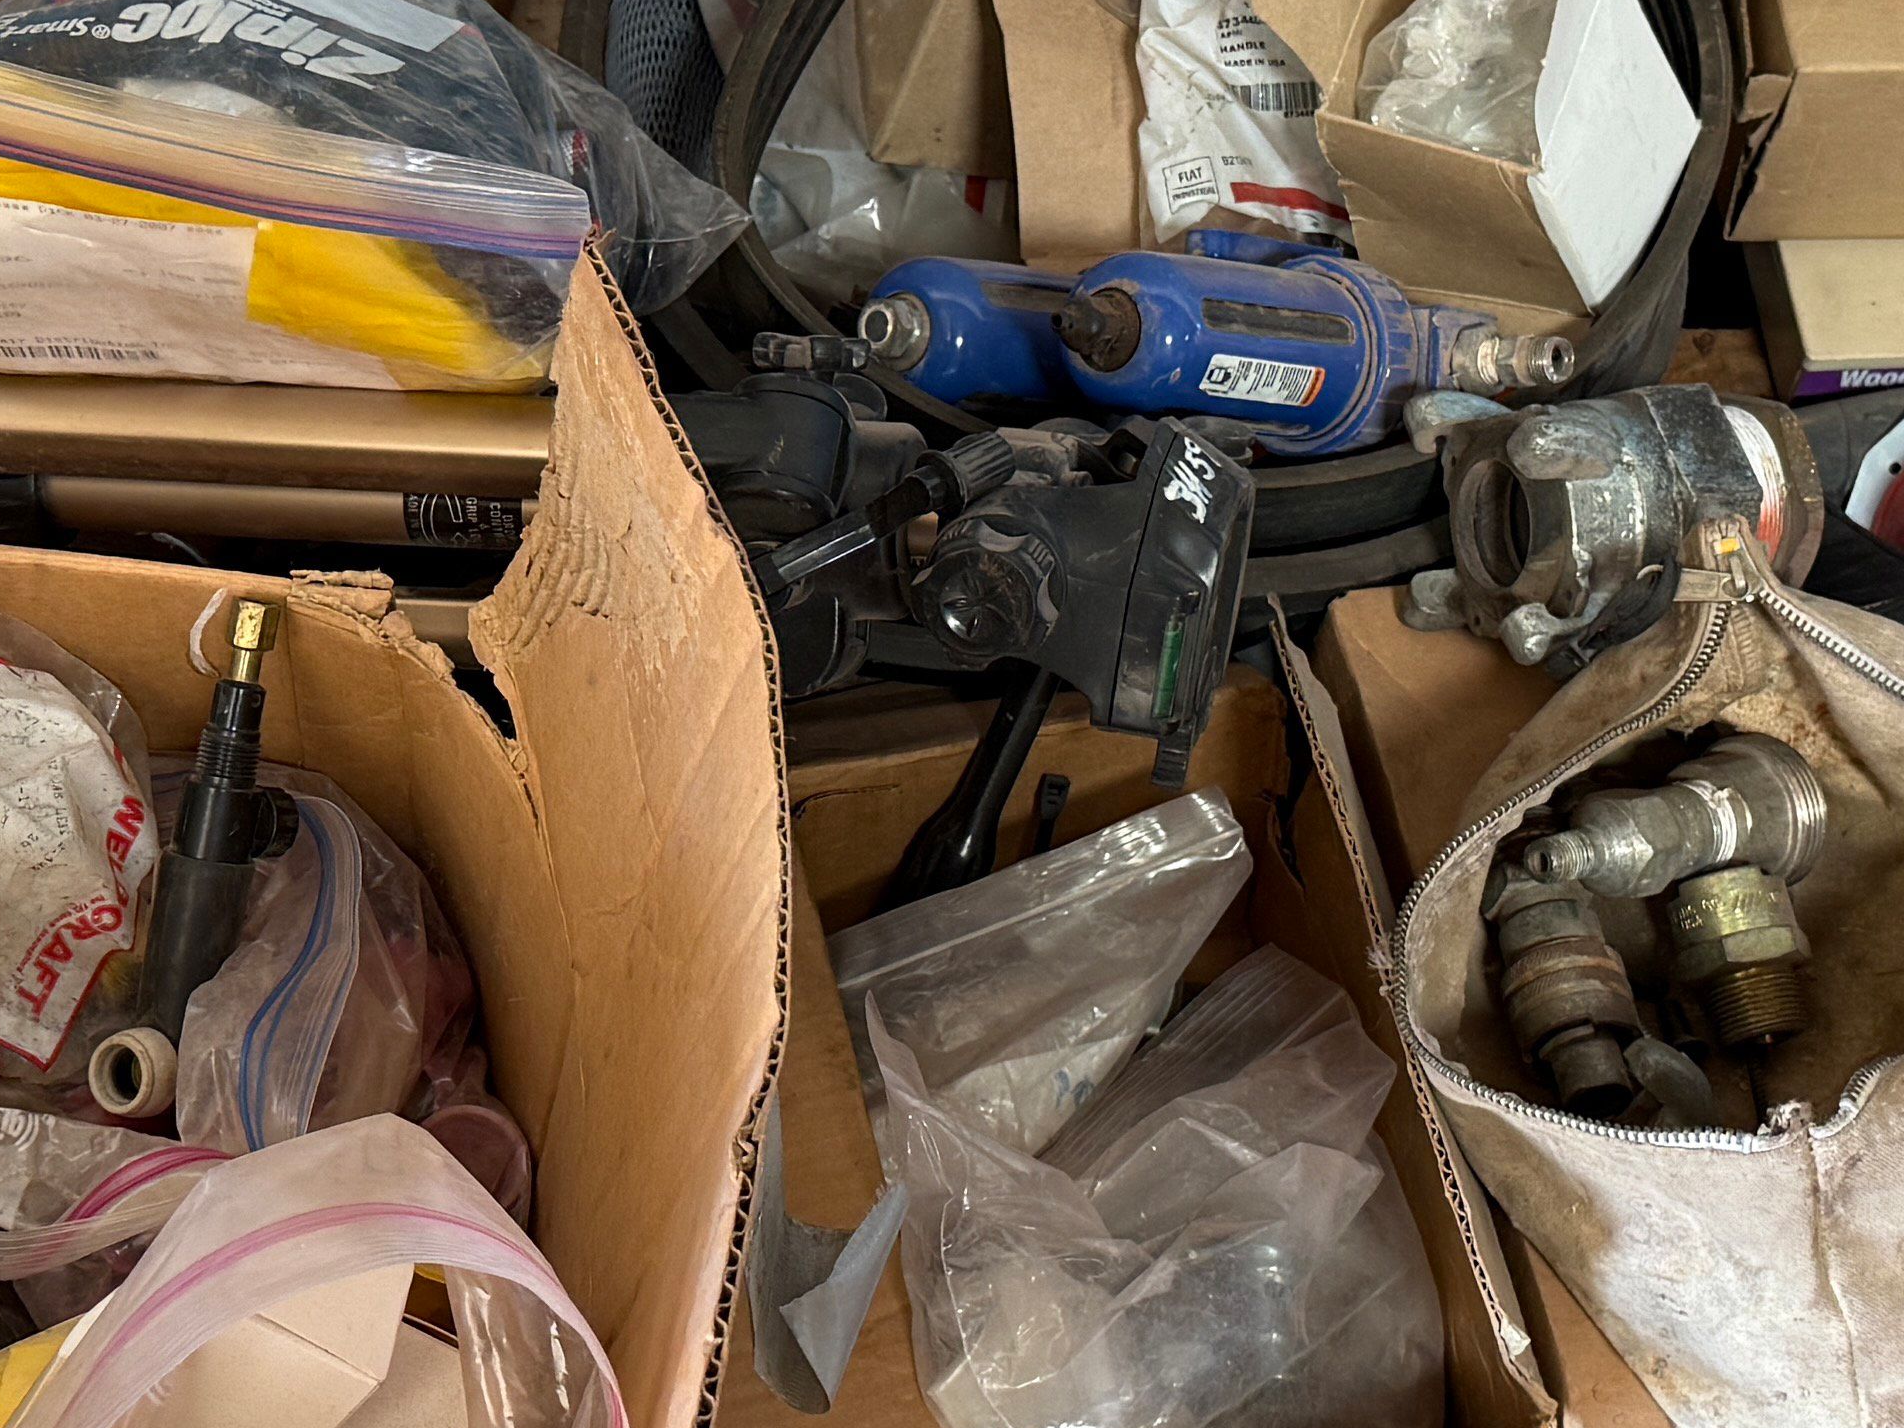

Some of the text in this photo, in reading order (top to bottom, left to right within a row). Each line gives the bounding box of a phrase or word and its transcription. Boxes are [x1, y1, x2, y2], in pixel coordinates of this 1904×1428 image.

[0, 16, 96, 39] Smart
[1219, 41, 1267, 54] HANDLE
[1223, 58, 1286, 68] MADE IN USA
[1177, 167, 1203, 183] FIAT
[465, 496, 478, 524] GRIP
